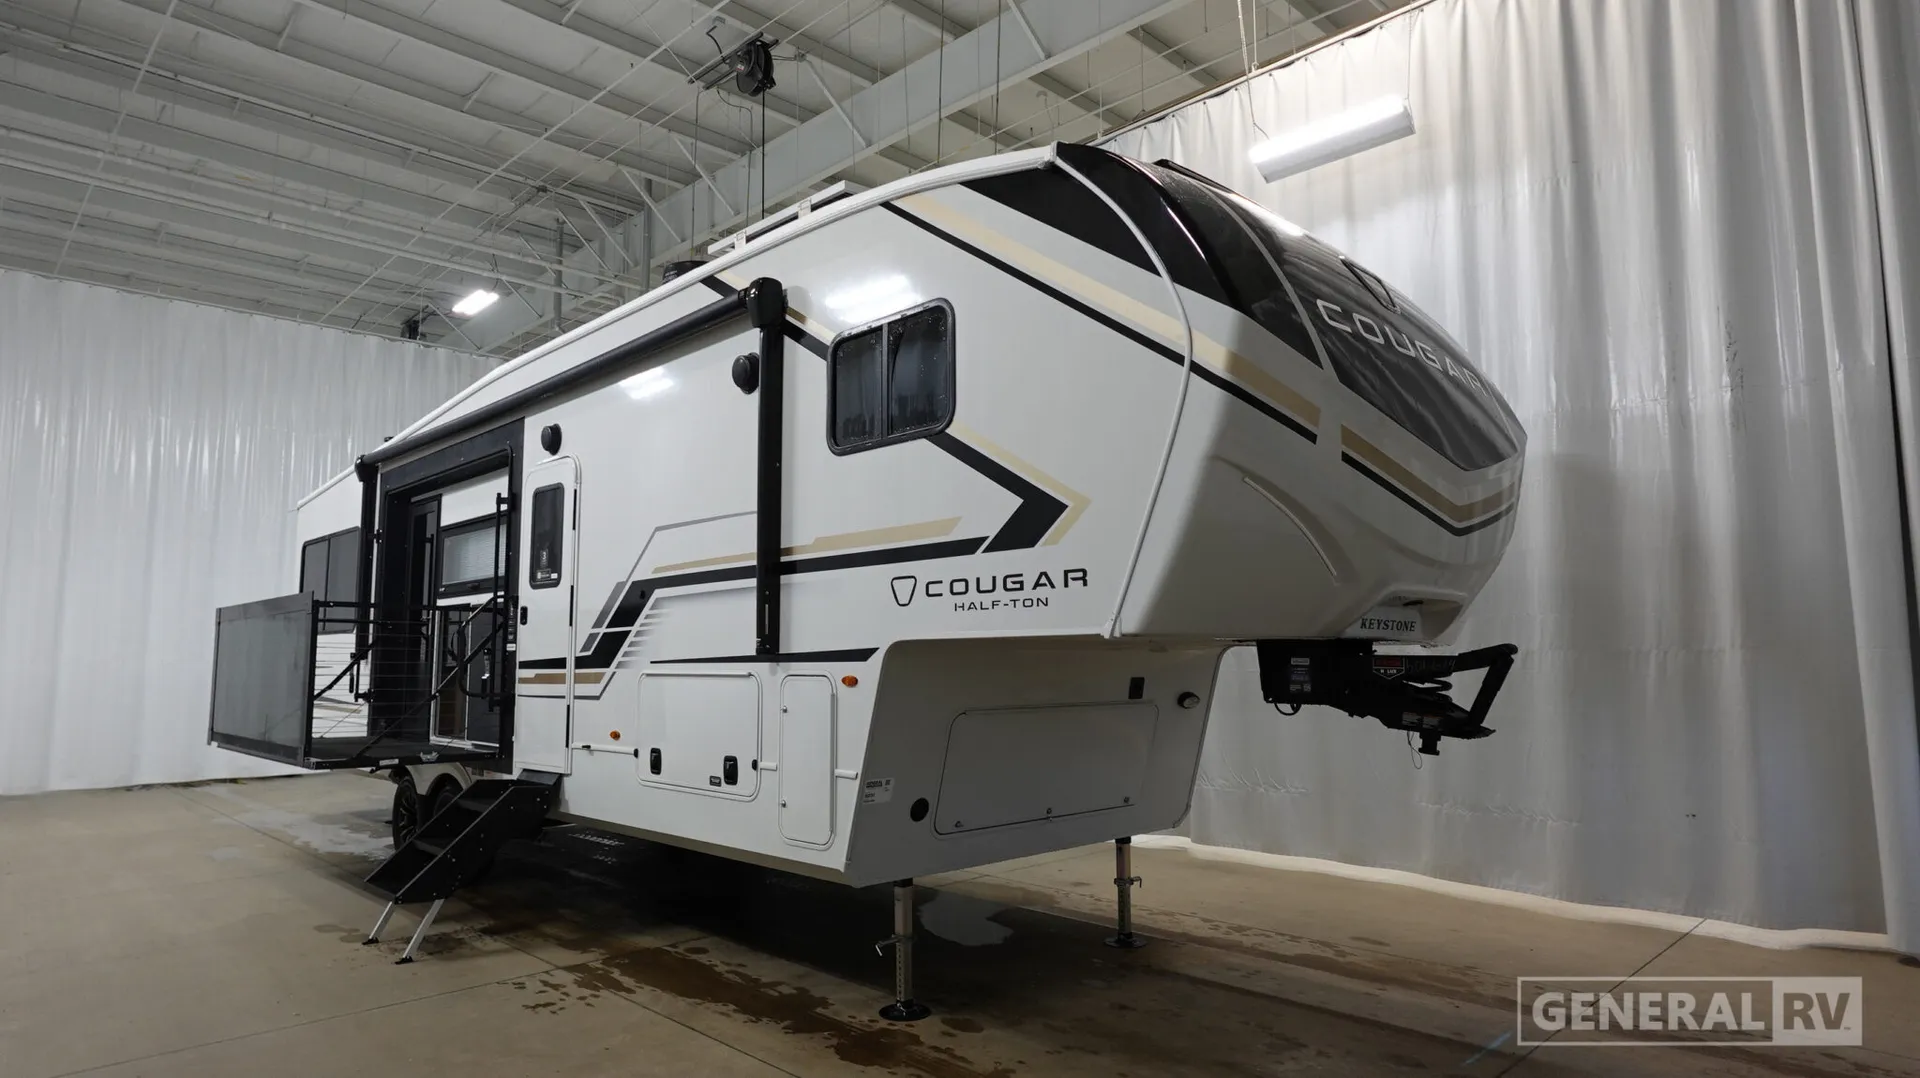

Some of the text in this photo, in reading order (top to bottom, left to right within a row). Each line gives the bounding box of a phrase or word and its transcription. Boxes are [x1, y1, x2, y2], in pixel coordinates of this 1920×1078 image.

[1316, 299, 1487, 396] COUGAR
[925, 568, 1088, 597] COUGAR
[954, 597, 1049, 612] HALF-TON
[1360, 617, 1417, 632] KEYSTONE
